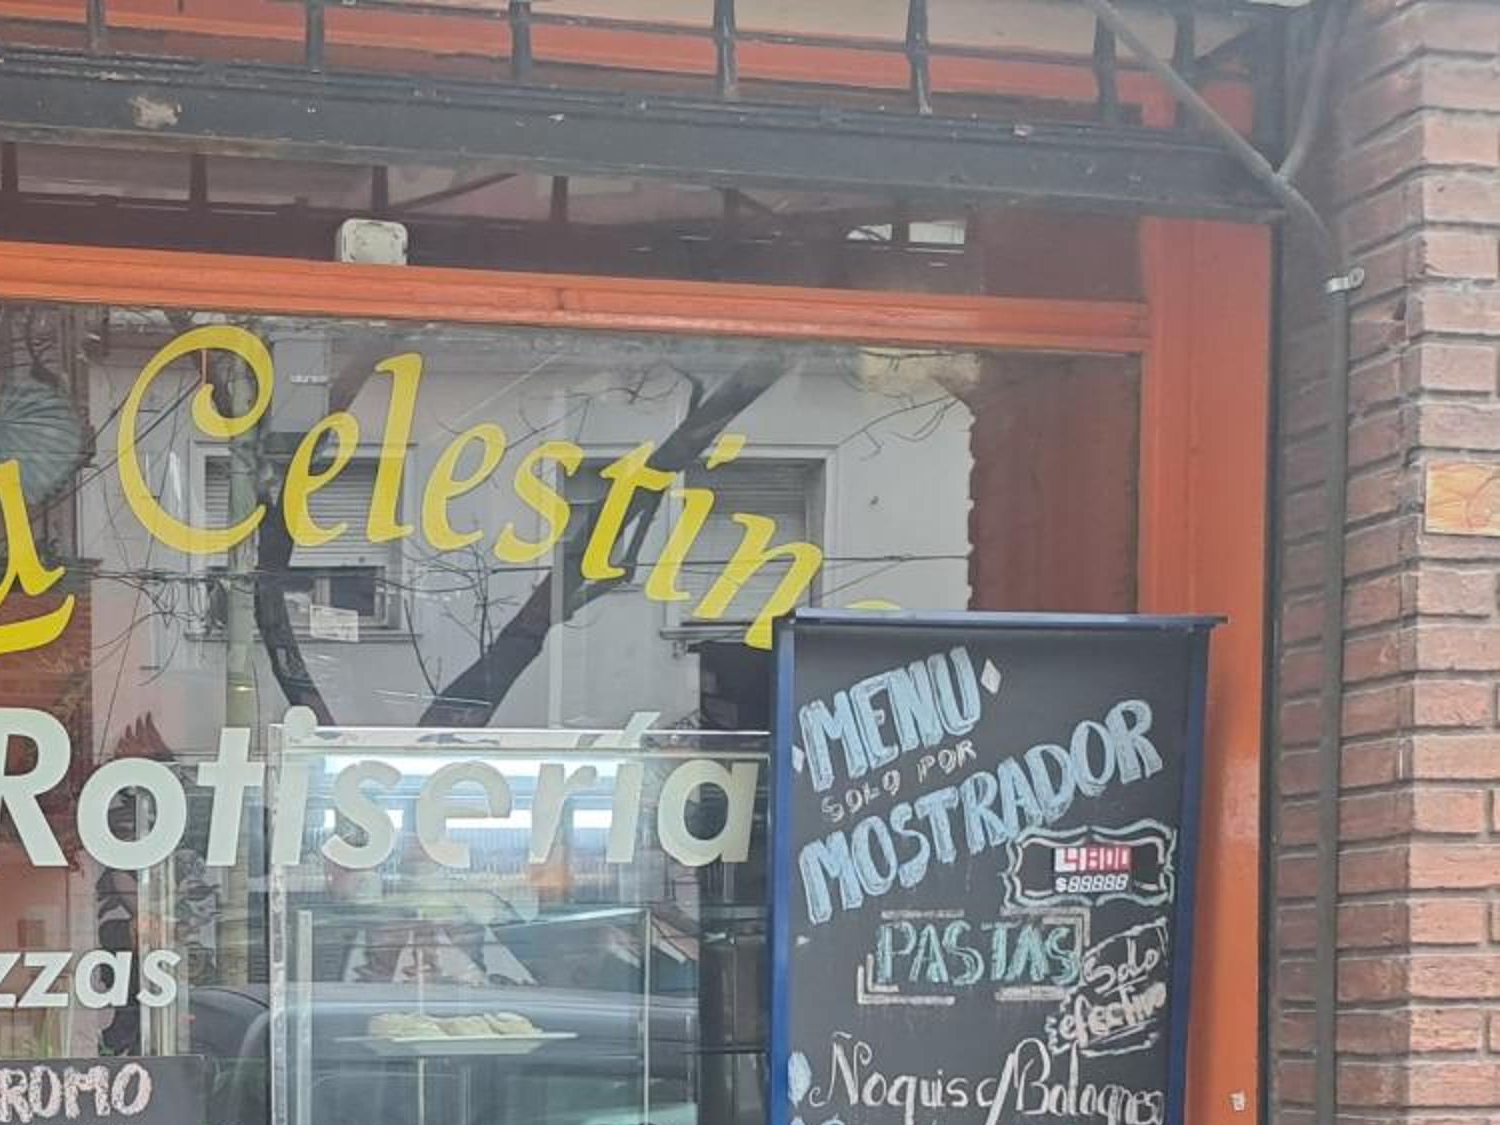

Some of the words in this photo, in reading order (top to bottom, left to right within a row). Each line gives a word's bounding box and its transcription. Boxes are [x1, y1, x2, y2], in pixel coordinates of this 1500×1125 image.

[118, 324, 900, 650] Celestin
[799, 645, 981, 793] MENU
[917, 738, 977, 784] POR
[799, 699, 1163, 926] MOSTRADOR
[876, 919, 1081, 985] PASTAS
